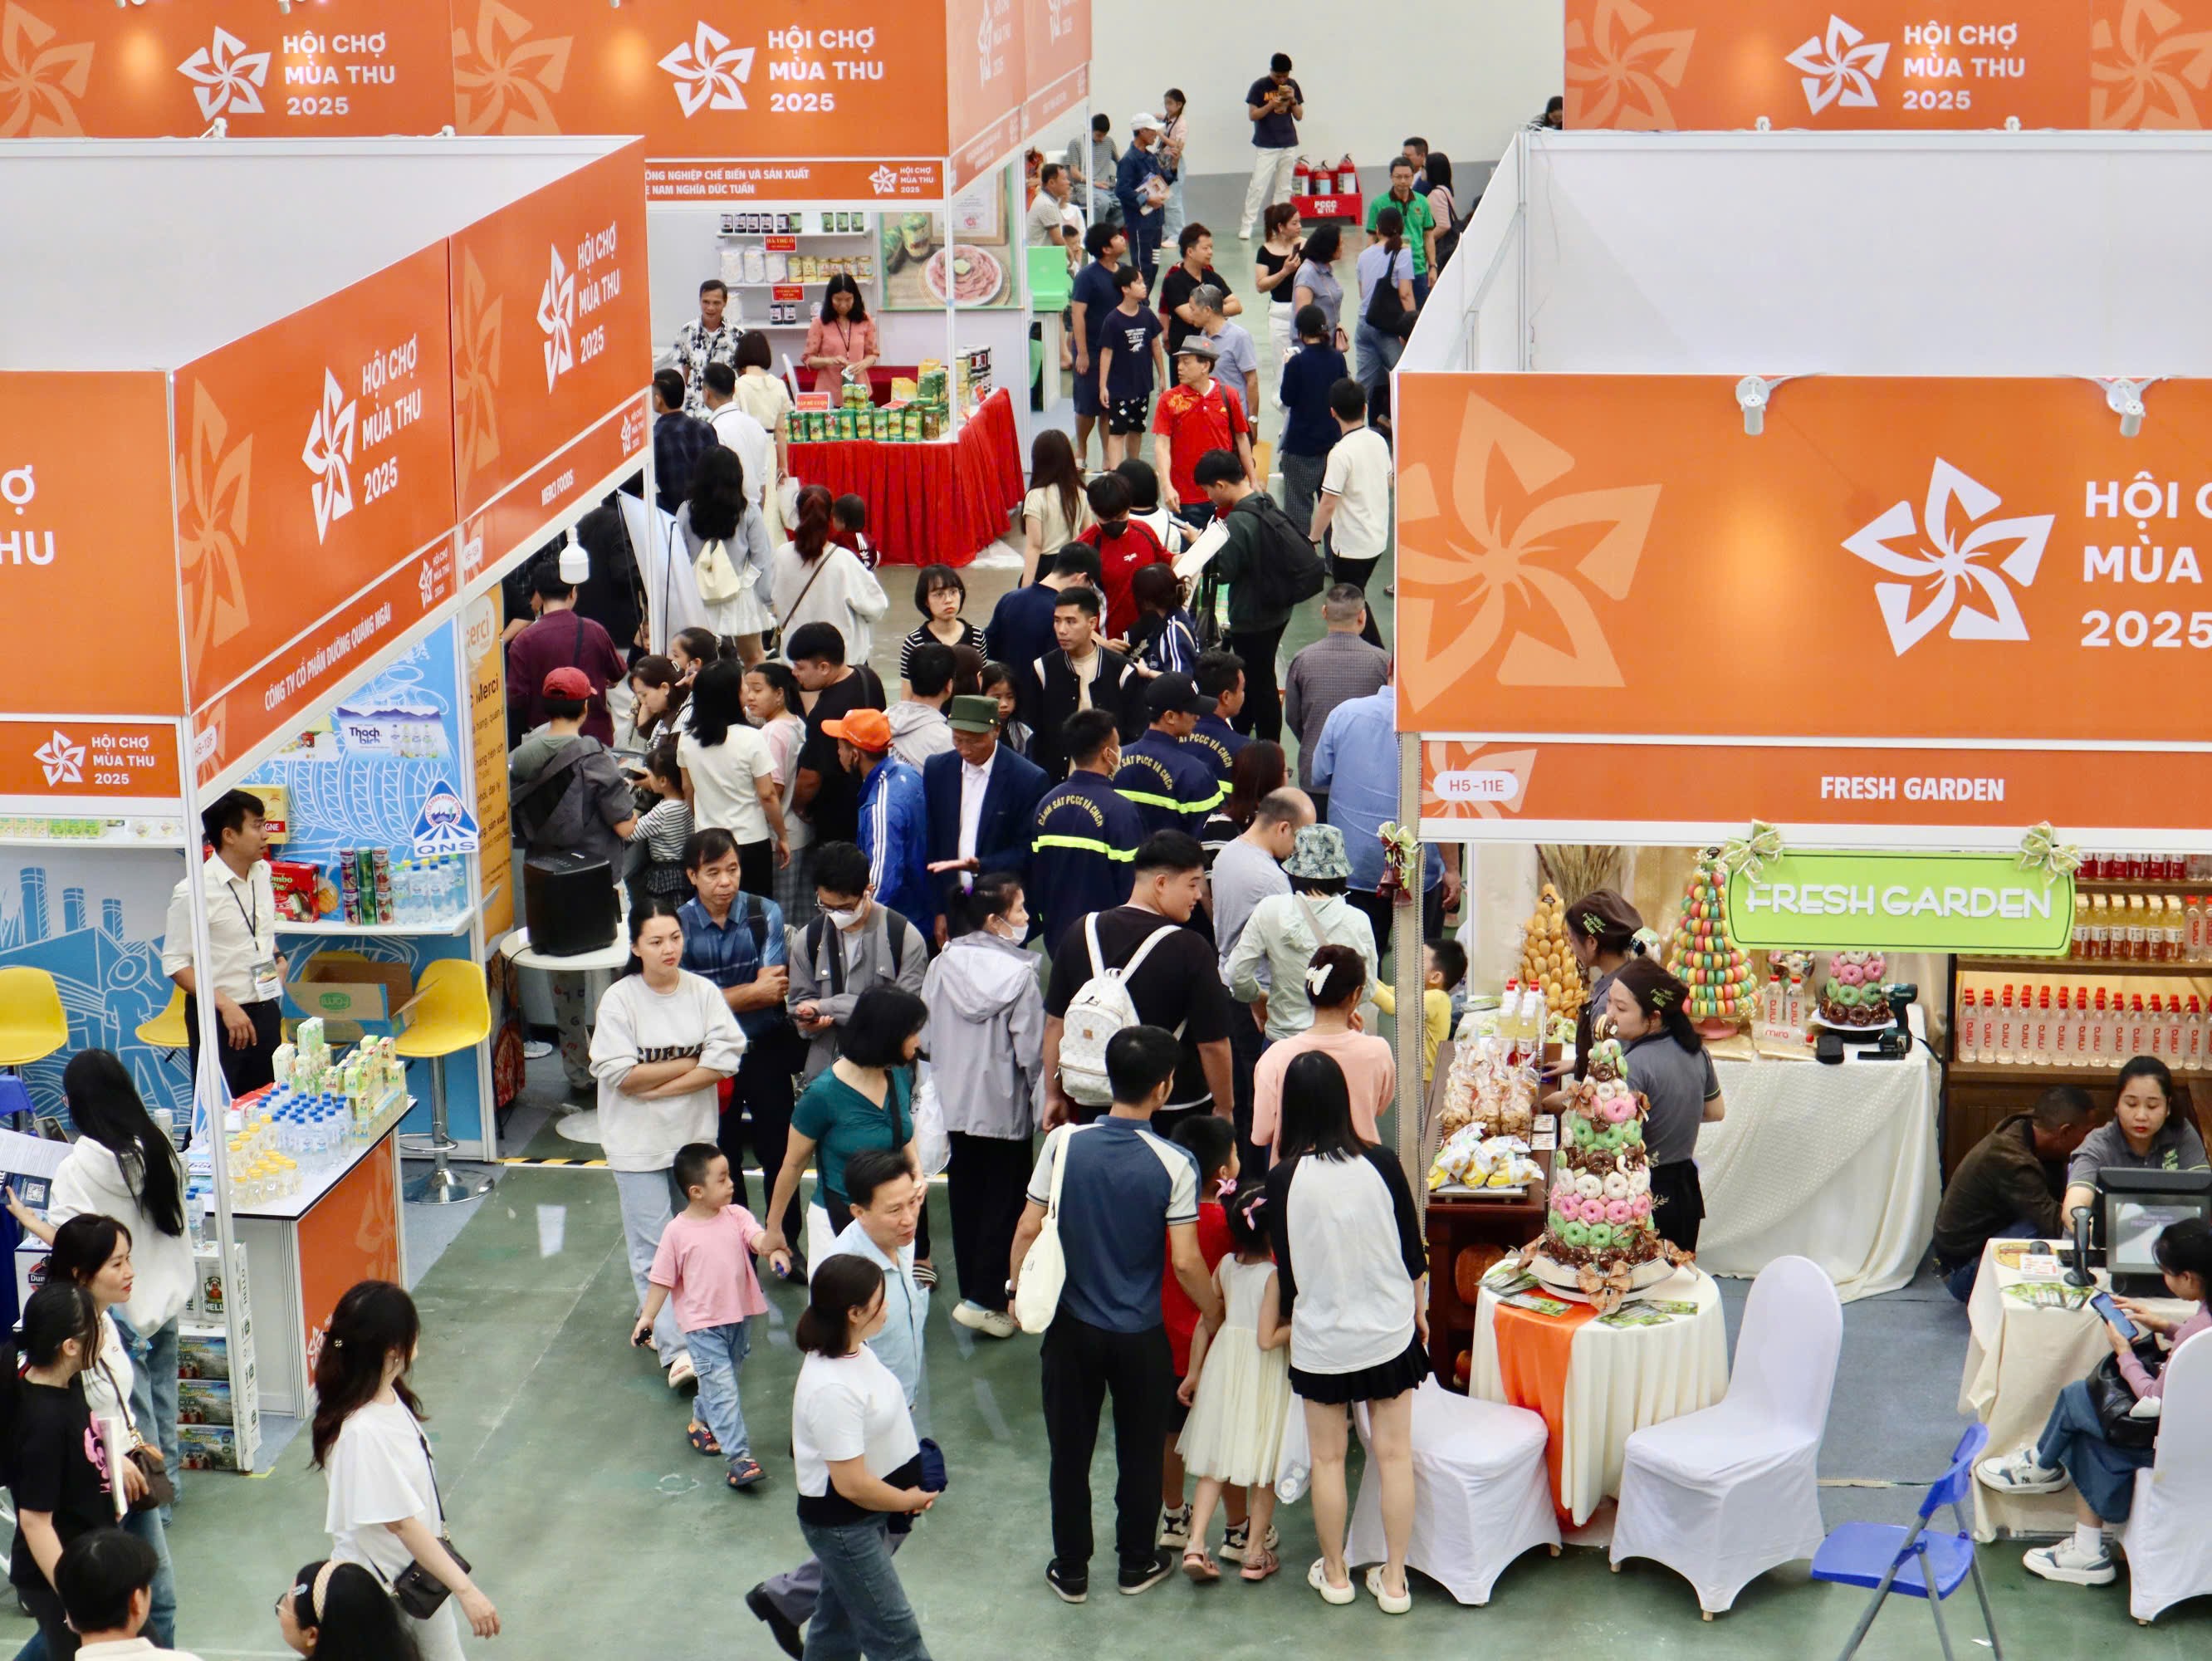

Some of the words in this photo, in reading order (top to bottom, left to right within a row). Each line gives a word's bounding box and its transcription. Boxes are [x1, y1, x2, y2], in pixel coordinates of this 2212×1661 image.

[282, 30, 325, 59] HỘI
[332, 32, 386, 58] CHỢ
[768, 25, 812, 56] HỘI
[819, 27, 875, 55] CHỢ
[1904, 20, 1950, 51] HỘI
[1958, 22, 2018, 51] CHỢ
[284, 61, 339, 85] MÙA
[345, 66, 395, 84] THU
[769, 57, 825, 81] MÙA
[832, 61, 883, 80] THU
[1903, 51, 1963, 77] MÙA
[1970, 57, 2025, 77] THU
[286, 96, 349, 115] 2025
[771, 92, 834, 112] 2025
[1902, 90, 1971, 110] 2025
[668, 169, 702, 182] NGHIỆP
[653, 184, 673, 194] NAM
[577, 232, 595, 275] HỘI
[595, 220, 616, 259] CHỢ
[579, 278, 600, 317] MÙA
[601, 267, 620, 302] THU
[580, 325, 604, 364] 2025
[362, 350, 386, 399] HỘI
[389, 332, 417, 380] CHỢ
[362, 402, 392, 452] MÙA
[394, 388, 422, 430] THU
[364, 456, 399, 505] 2025
[541, 480, 556, 507] MERCI
[556, 468, 574, 496] FOODS
[2085, 470, 2179, 530] HỘI
[2083, 534, 2203, 584] MÙA
[2081, 610, 2212, 649] 2025
[265, 684, 286, 712] CÔNG
[285, 672, 296, 697] TY
[296, 656, 306, 688] CỔ
[91, 734, 115, 751] HỘI
[119, 735, 149, 751] CHỢ
[1189, 733, 1210, 745] PCCC
[92, 752, 123, 767] MÙA
[127, 756, 154, 767] THU
[1121, 754, 1134, 767] SÁT
[94, 773, 130, 785] 2025
[1449, 779, 1505, 792] H5-11E
[1820, 775, 1896, 800] FRESH
[1903, 777, 2005, 801] GARDEN
[1065, 795, 1084, 806] PCCC
[417, 841, 476, 855] QNS
[1745, 882, 1875, 915] FRESH
[1881, 884, 2051, 919] GARDEN
[1769, 999, 1777, 1024] mira
[1764, 1028, 1789, 1039] mira
[1984, 1022, 1992, 1048] mira
[2021, 1023, 2029, 1049] mira
[2057, 1025, 2065, 1051] mira
[2077, 1026, 2086, 1051] mira
[2115, 1026, 2123, 1052] mira
[2132, 1027, 2141, 1052] mira
[2152, 1027, 2161, 1052] mira
[2170, 1029, 2179, 1054] mira
[2190, 1029, 2199, 1055] mira
